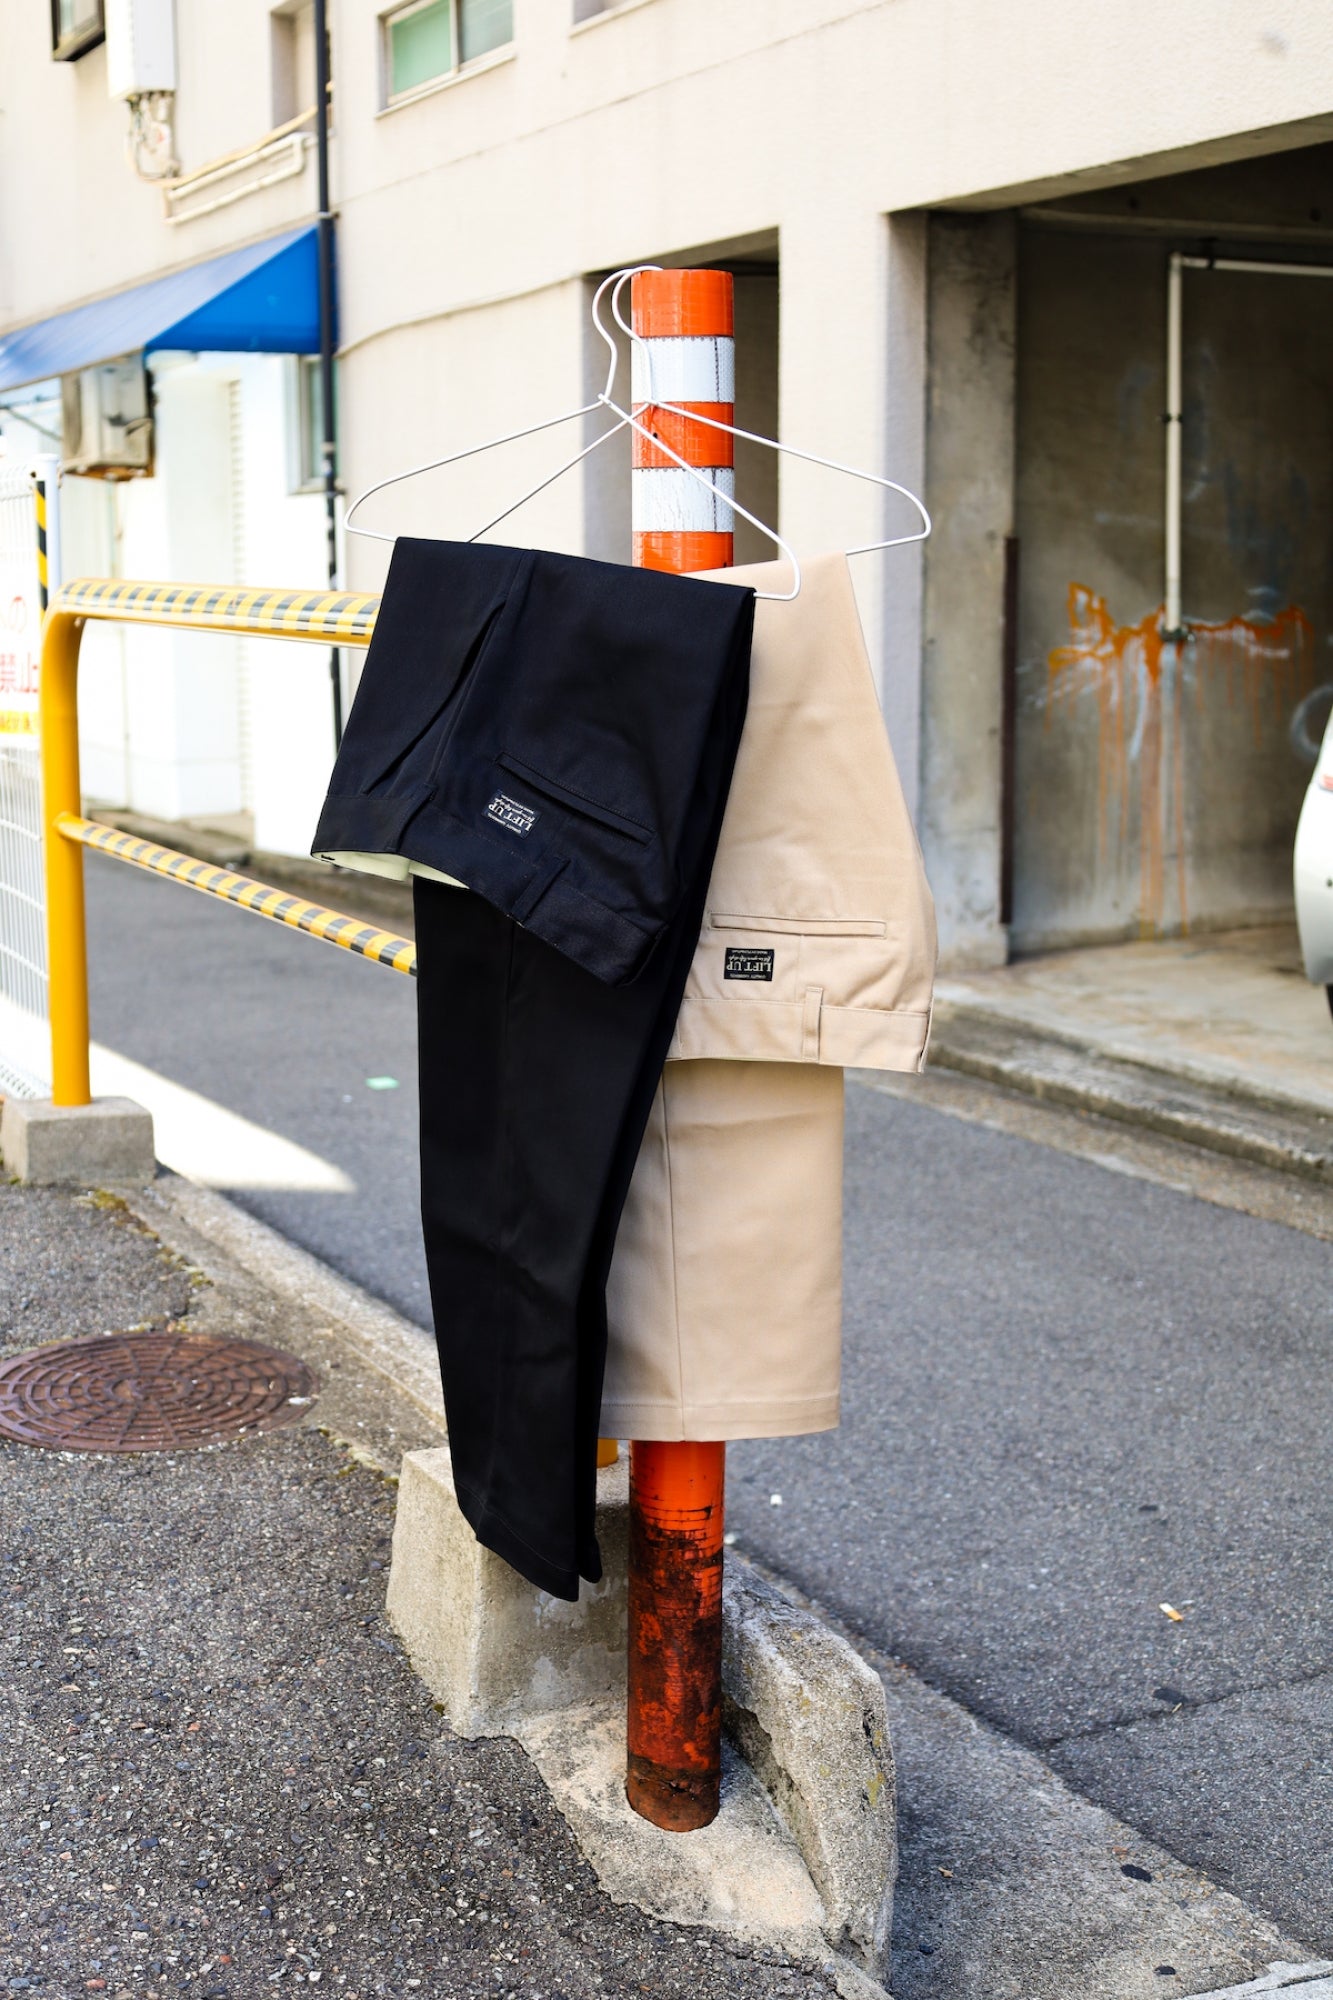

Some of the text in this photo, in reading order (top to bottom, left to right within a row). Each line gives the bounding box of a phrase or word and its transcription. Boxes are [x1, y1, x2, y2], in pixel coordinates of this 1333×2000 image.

[488, 803, 505, 817] UP
[503, 812, 533, 831] LIFT
[726, 961, 772, 972] LIFT UP
